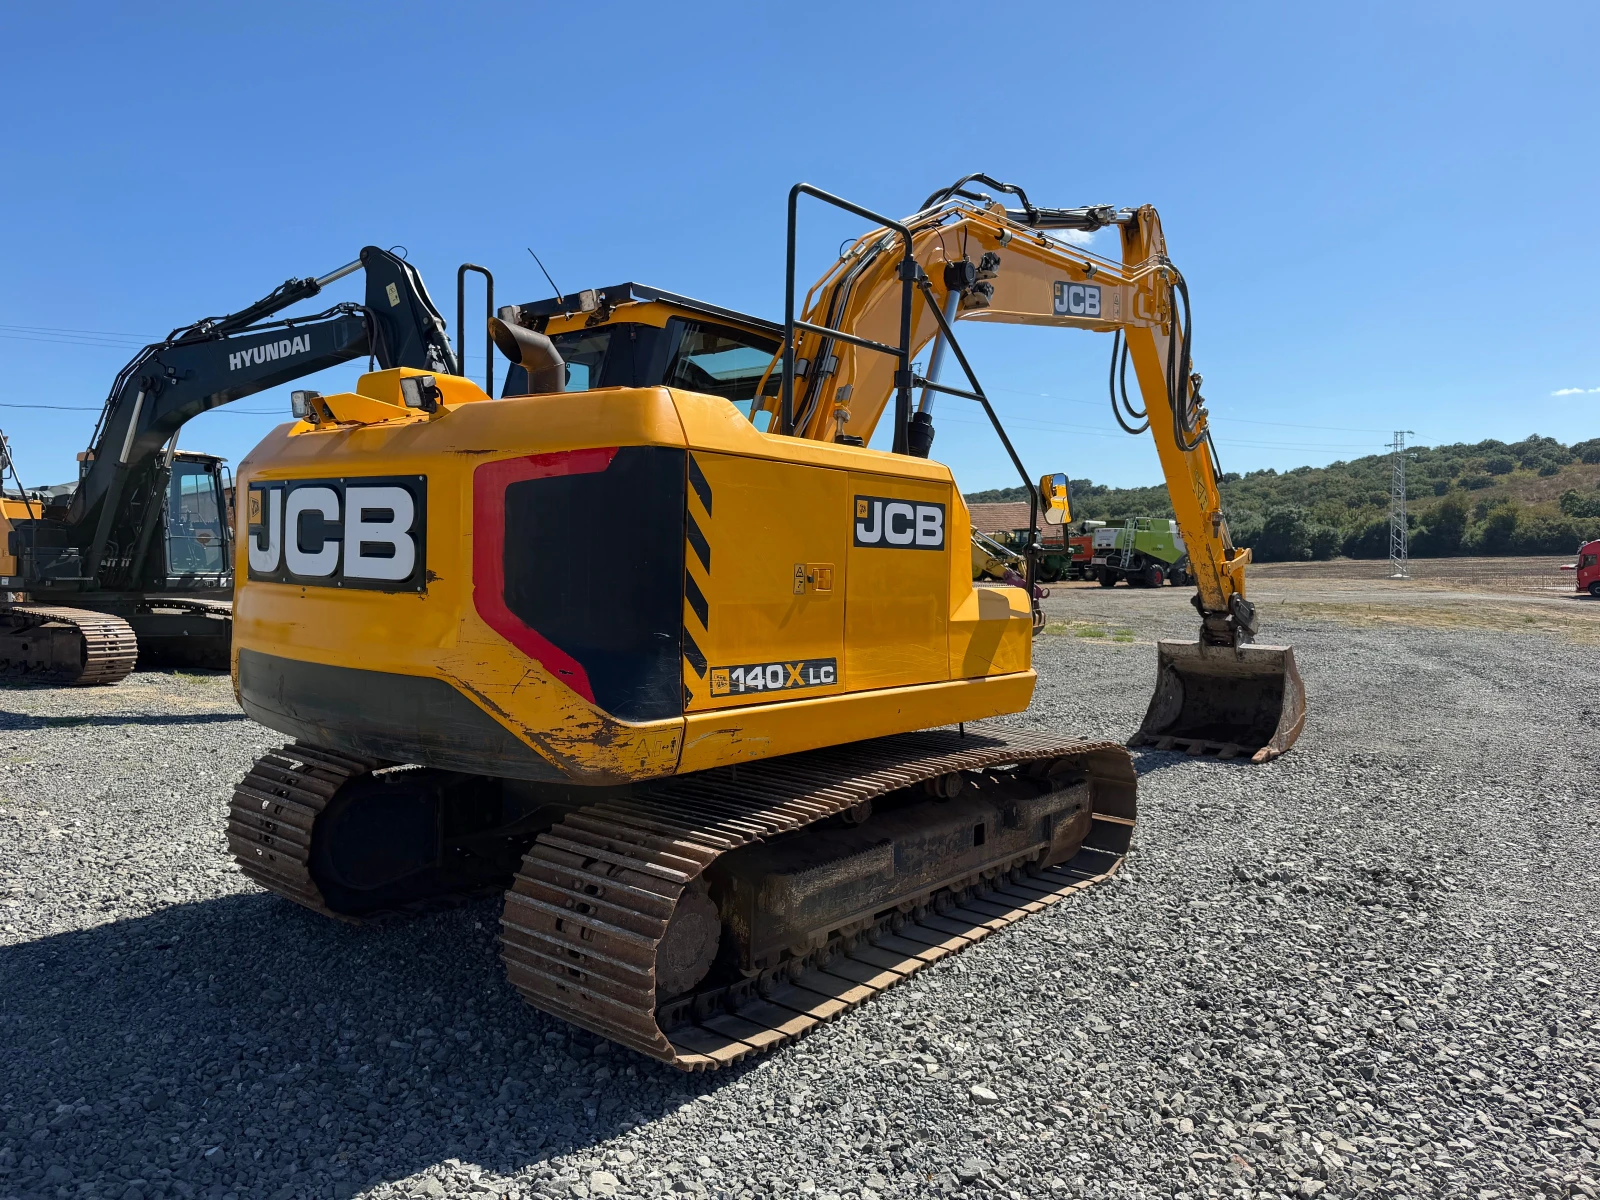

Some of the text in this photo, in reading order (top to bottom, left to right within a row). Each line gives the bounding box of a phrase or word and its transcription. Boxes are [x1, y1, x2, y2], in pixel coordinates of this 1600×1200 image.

[1055, 285, 1100, 315] JCB
[229, 334, 311, 371] HYUNDAI
[248, 487, 415, 580] JCB
[857, 501, 943, 546] JCB
[731, 663, 806, 692] 140X
[809, 666, 834, 685] LC
